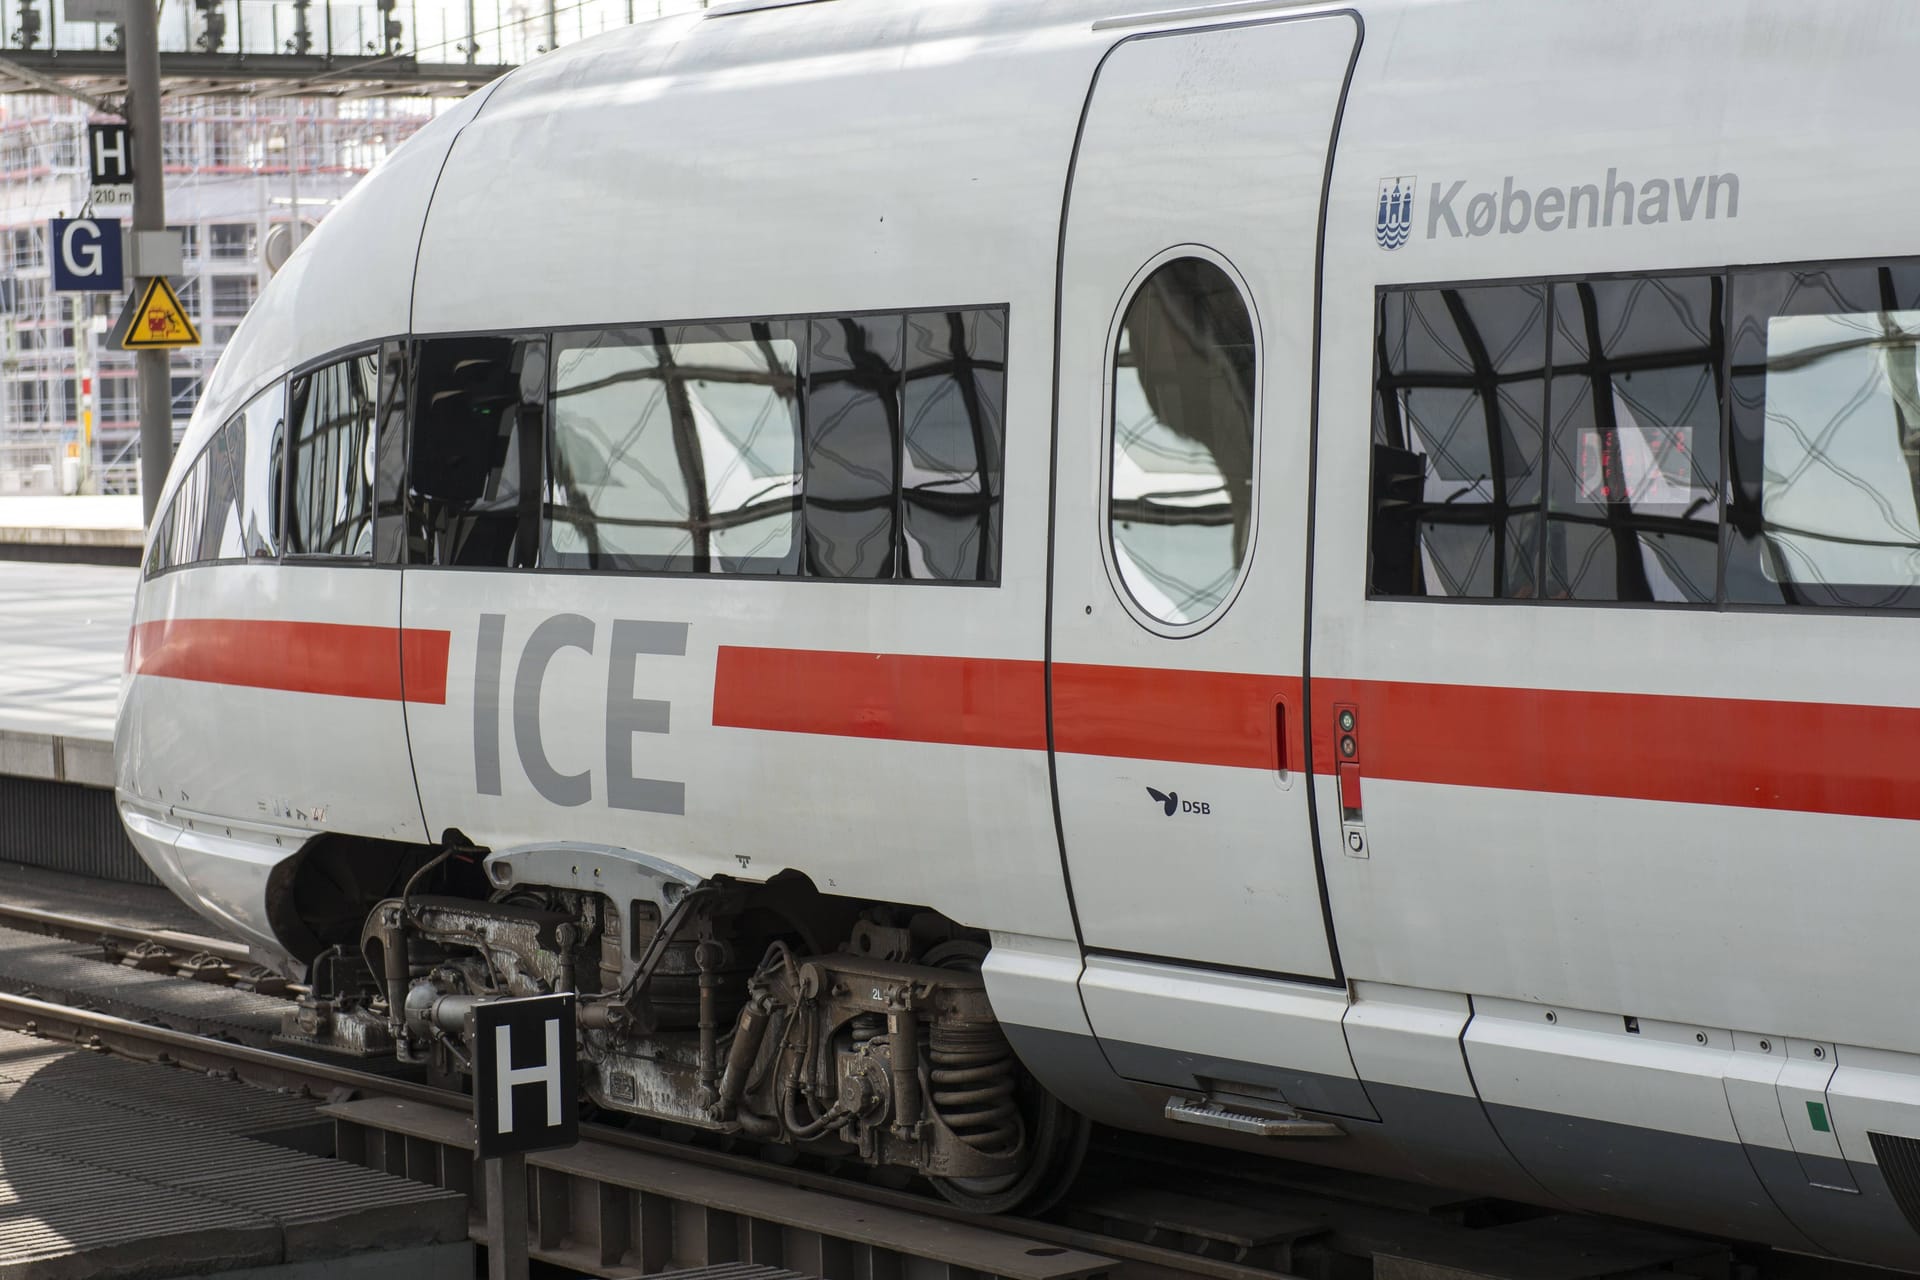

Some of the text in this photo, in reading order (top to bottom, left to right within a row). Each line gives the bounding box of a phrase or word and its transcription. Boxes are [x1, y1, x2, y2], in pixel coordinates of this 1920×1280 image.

[95, 130, 126, 176] H
[95, 190, 131, 204] 210 m
[1426, 167, 1740, 239] København
[62, 219, 103, 277] G
[473, 613, 689, 816] ICE
[1182, 800, 1211, 815] DSB
[872, 988, 883, 1000] 2L
[495, 1018, 562, 1134] H
